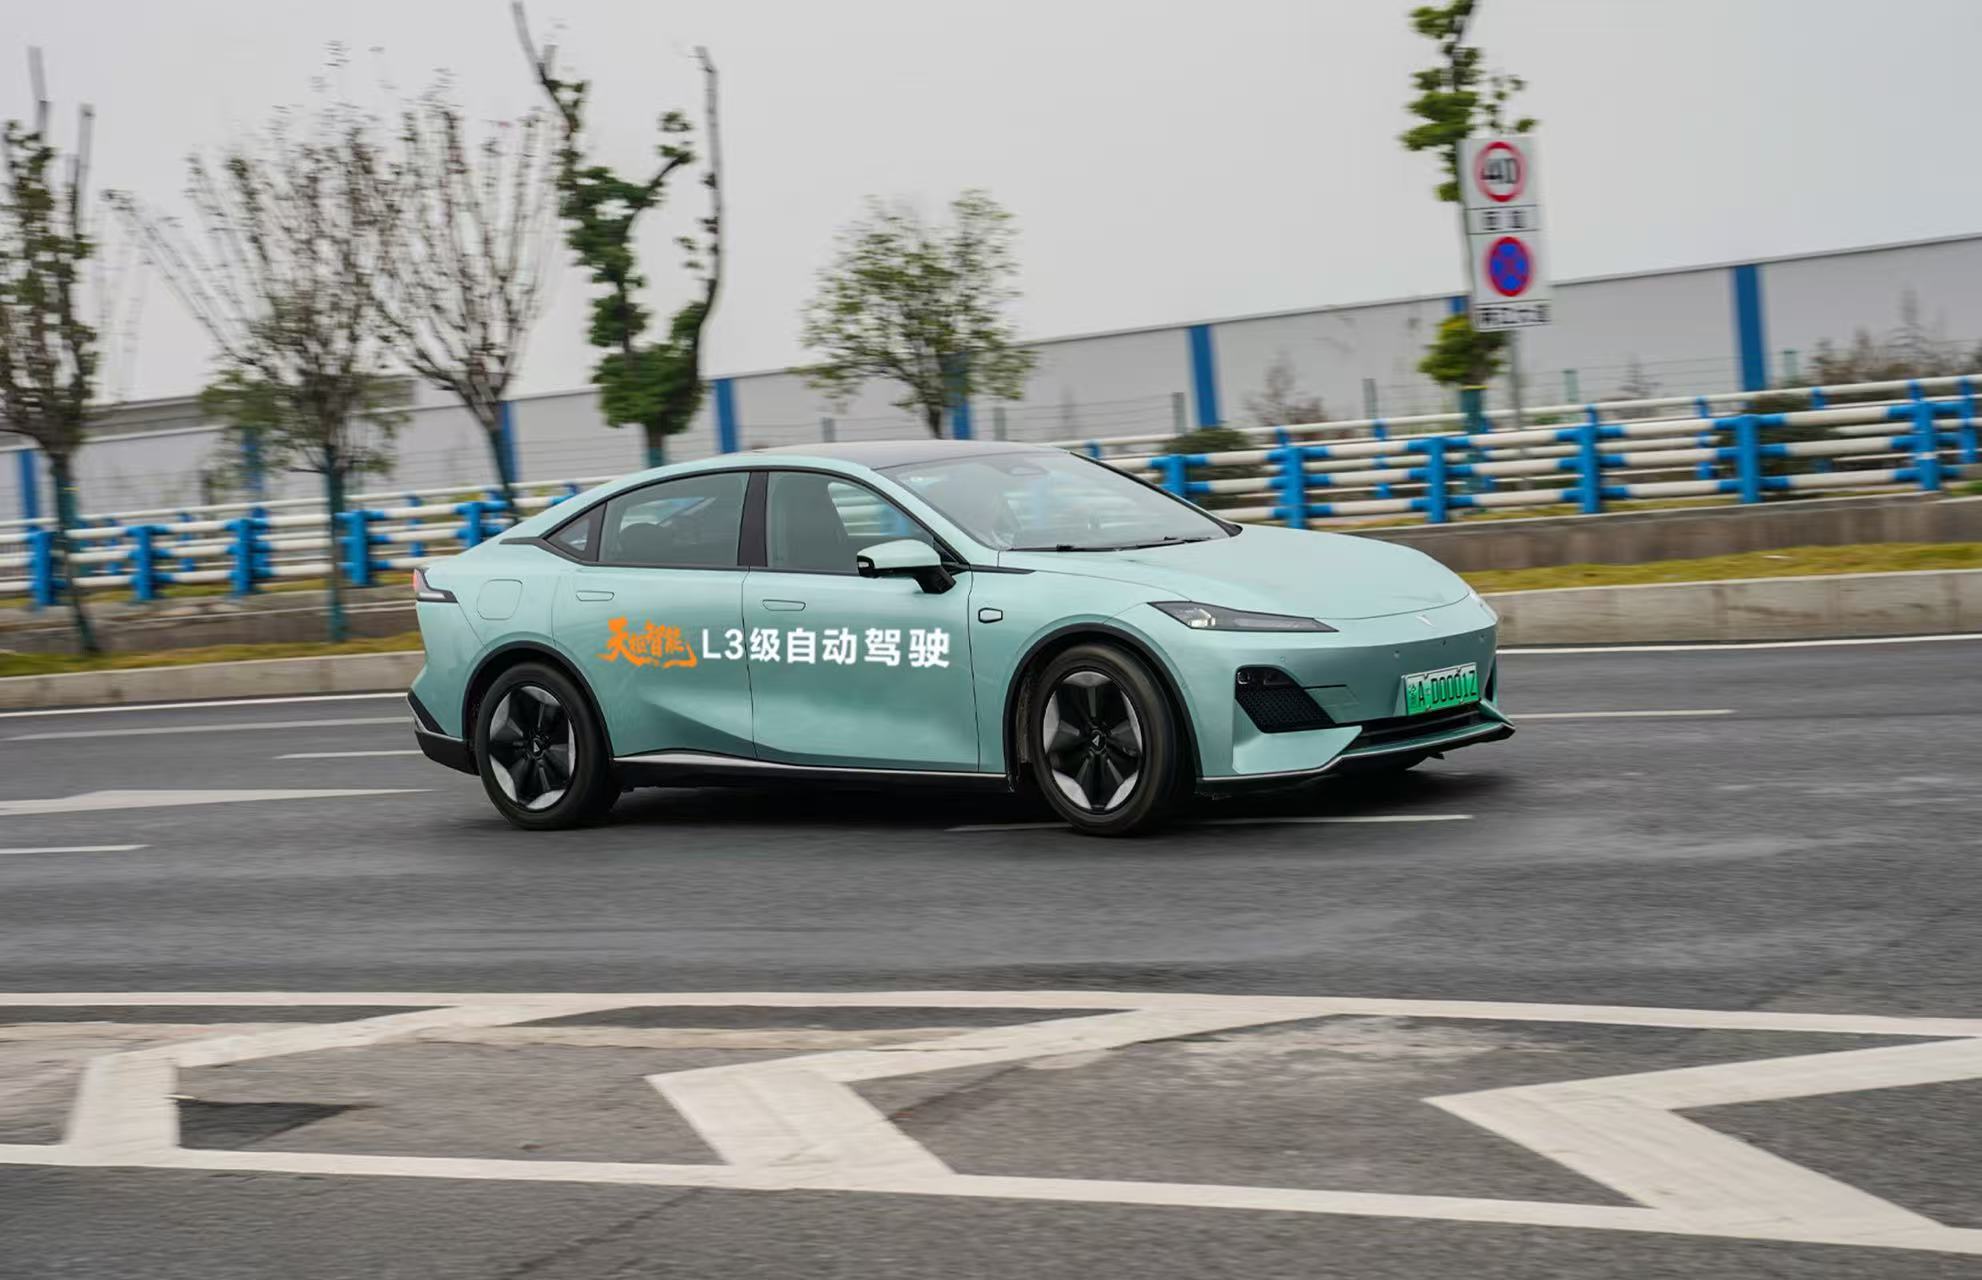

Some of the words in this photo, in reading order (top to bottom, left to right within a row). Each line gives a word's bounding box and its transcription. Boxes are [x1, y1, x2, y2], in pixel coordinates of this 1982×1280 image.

[701, 627, 951, 668] L3级自动驾驶
